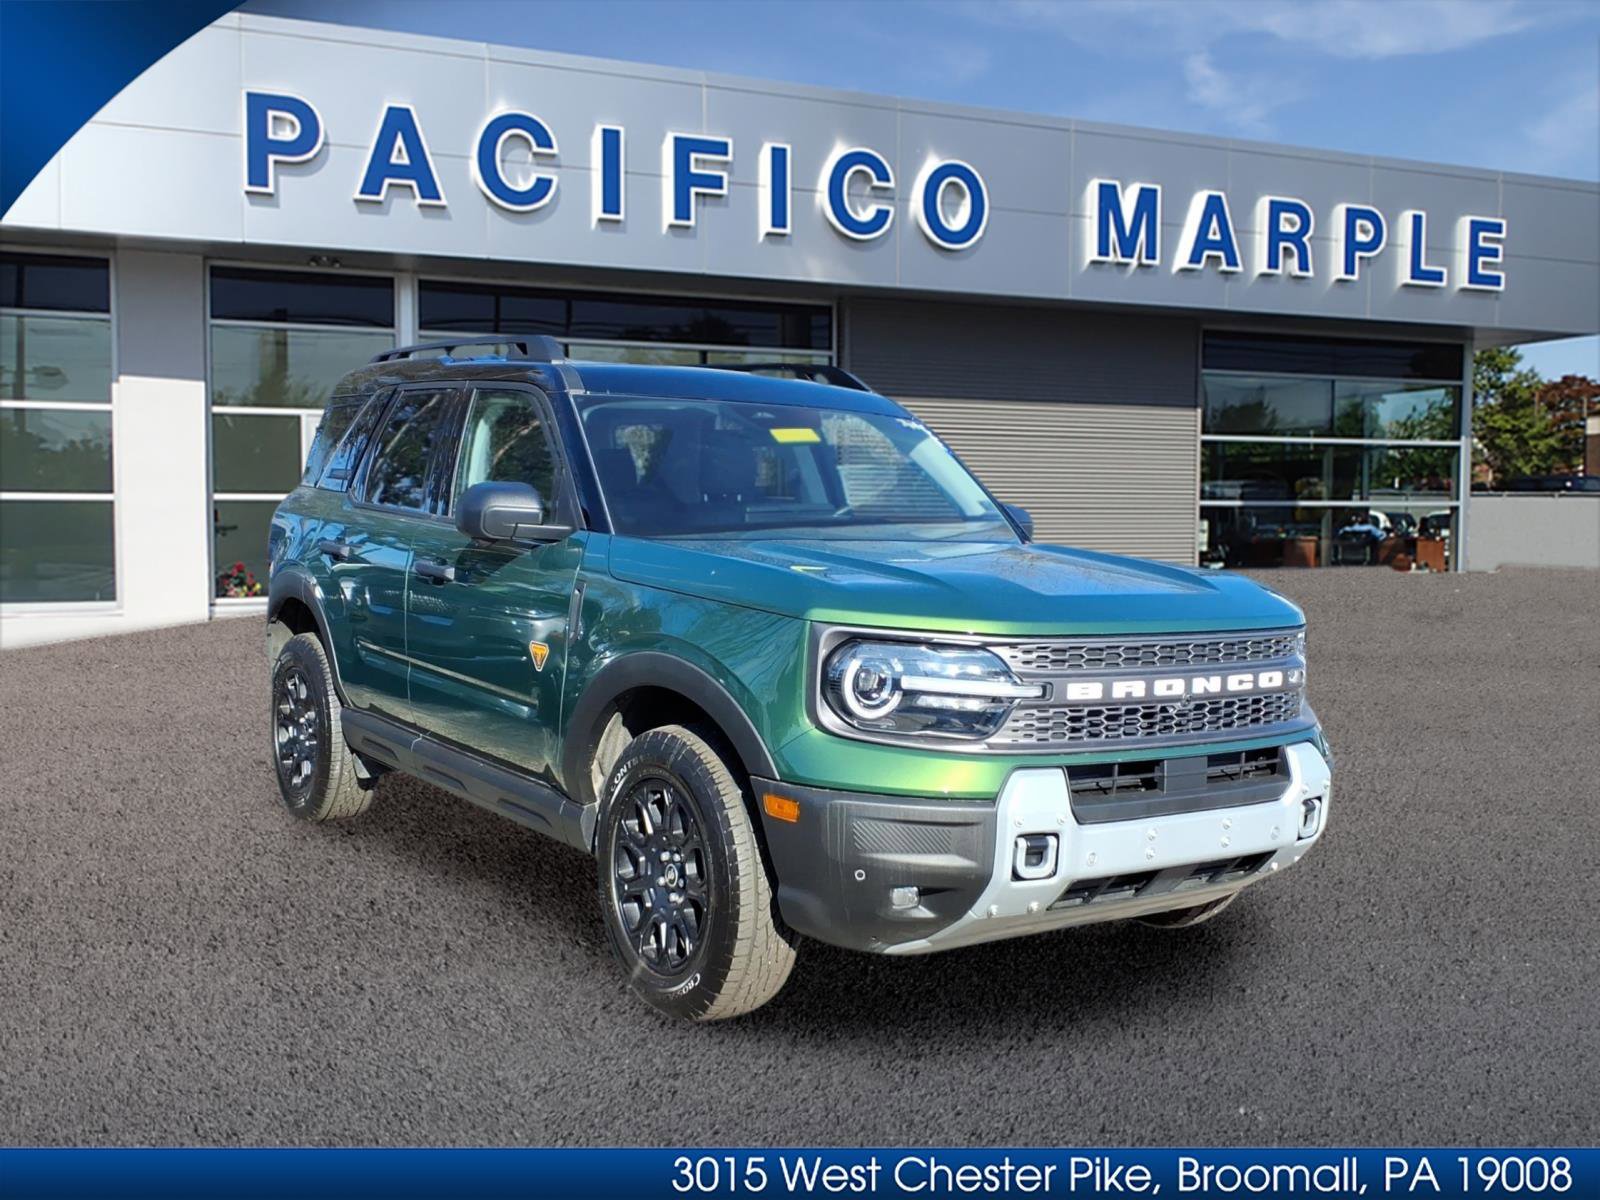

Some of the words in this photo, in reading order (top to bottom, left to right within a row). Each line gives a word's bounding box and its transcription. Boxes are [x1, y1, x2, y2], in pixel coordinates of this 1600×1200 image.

[243, 90, 989, 250] PACIFICO
[1087, 178, 1506, 291] MARPLE
[1066, 671, 1282, 700] BRONCO
